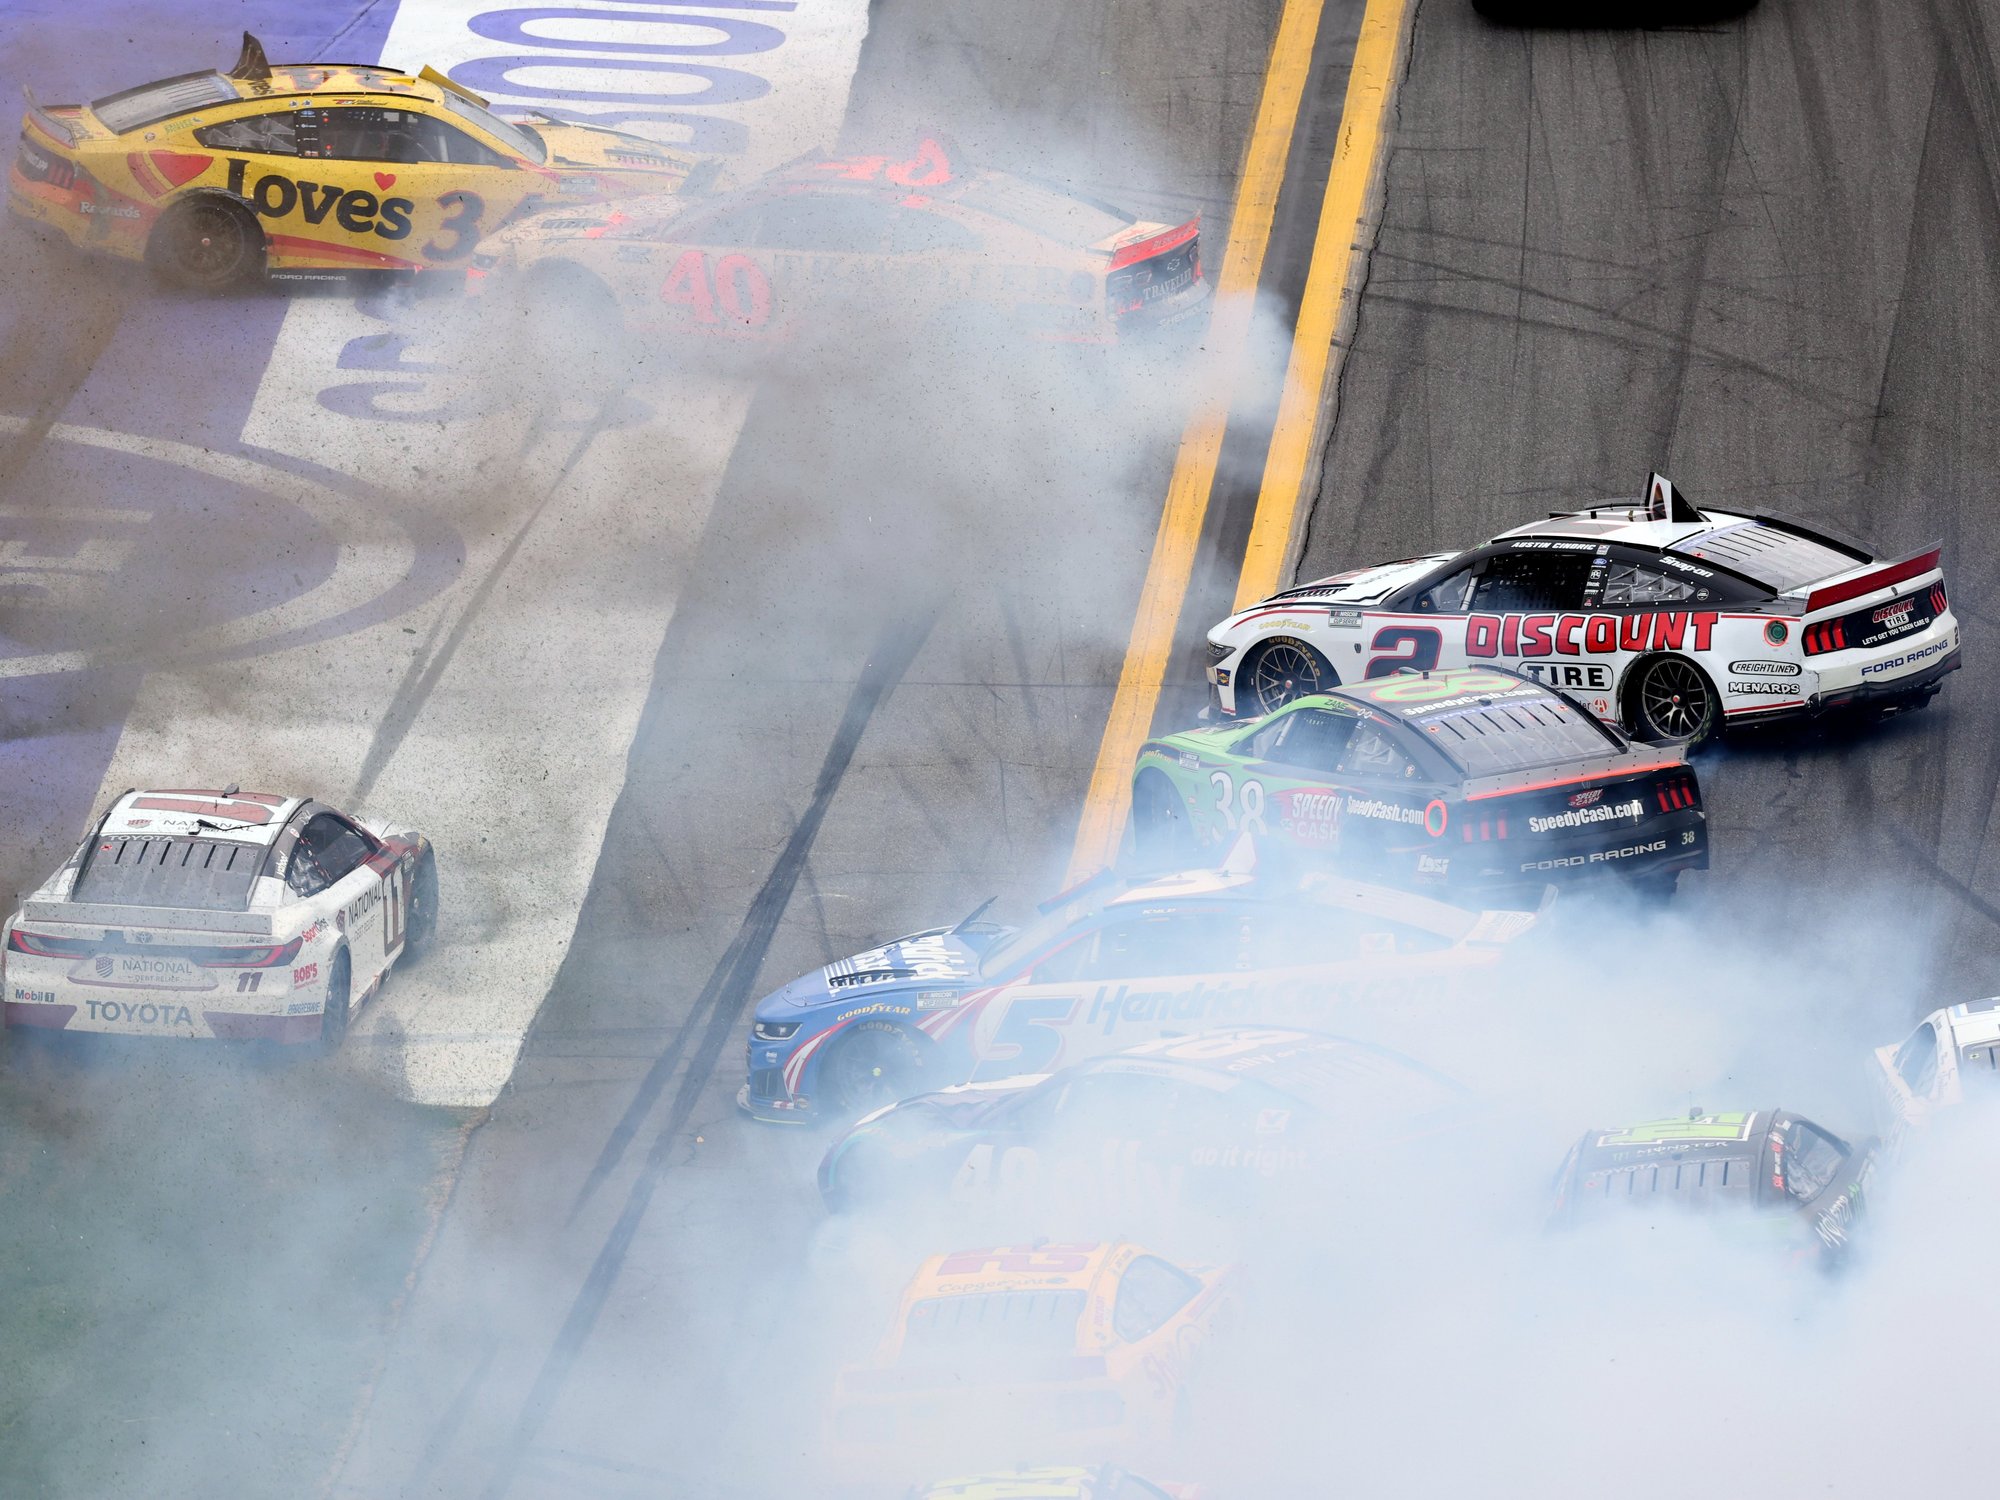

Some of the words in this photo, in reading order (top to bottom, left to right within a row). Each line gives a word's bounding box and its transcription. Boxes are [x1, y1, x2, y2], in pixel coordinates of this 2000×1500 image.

[660, 250, 772, 328] 40
[1511, 541, 1551, 549] AUSTIN
[1552, 542, 1597, 551] CINDRIC
[1659, 556, 1715, 578] Snap-on
[1872, 598, 1915, 624] DISCOUNT
[1886, 614, 1907, 627] TIRE
[1258, 618, 1312, 632] GOODYEAR
[1466, 611, 1718, 658] DISCOUNT
[1862, 634, 1878, 645] LET'S
[1878, 630, 1888, 640] GET
[1888, 627, 1899, 637] YOU
[1898, 621, 1914, 633] TAKEN
[1913, 618, 1925, 628] CARE
[1953, 626, 1960, 646] 2
[1269, 635, 1321, 677] GOODYEAR
[1364, 625, 1442, 680] 2
[1861, 657, 1904, 676] FORD
[1906, 638, 1948, 663] RACING
[1527, 665, 1606, 687] TIRE
[1735, 663, 1796, 674] FREIGHTLINER
[1728, 681, 1800, 695] MENARDS
[1324, 698, 1348, 711] ZANE
[1402, 688, 1542, 717] SpeedyCash.com
[1209, 769, 1268, 843] 38
[1291, 792, 1343, 823] SPEEDY
[1346, 795, 1425, 826] SpeedyCash.com
[1529, 800, 1644, 833] SpeedyCash.com
[1681, 830, 1695, 846] 38
[1520, 855, 1585, 873] FORD
[1589, 840, 1667, 863] RACING
[348, 880, 383, 927] NATIONAL
[121, 959, 193, 975] NATIONAL
[293, 962, 318, 984] BOB'S
[15, 988, 44, 1002] Mobil
[236, 971, 264, 993] 11
[85, 1000, 194, 1026] TOYOTA
[837, 1001, 911, 1022] GOODYEAR
[974, 995, 1082, 1077] 5
